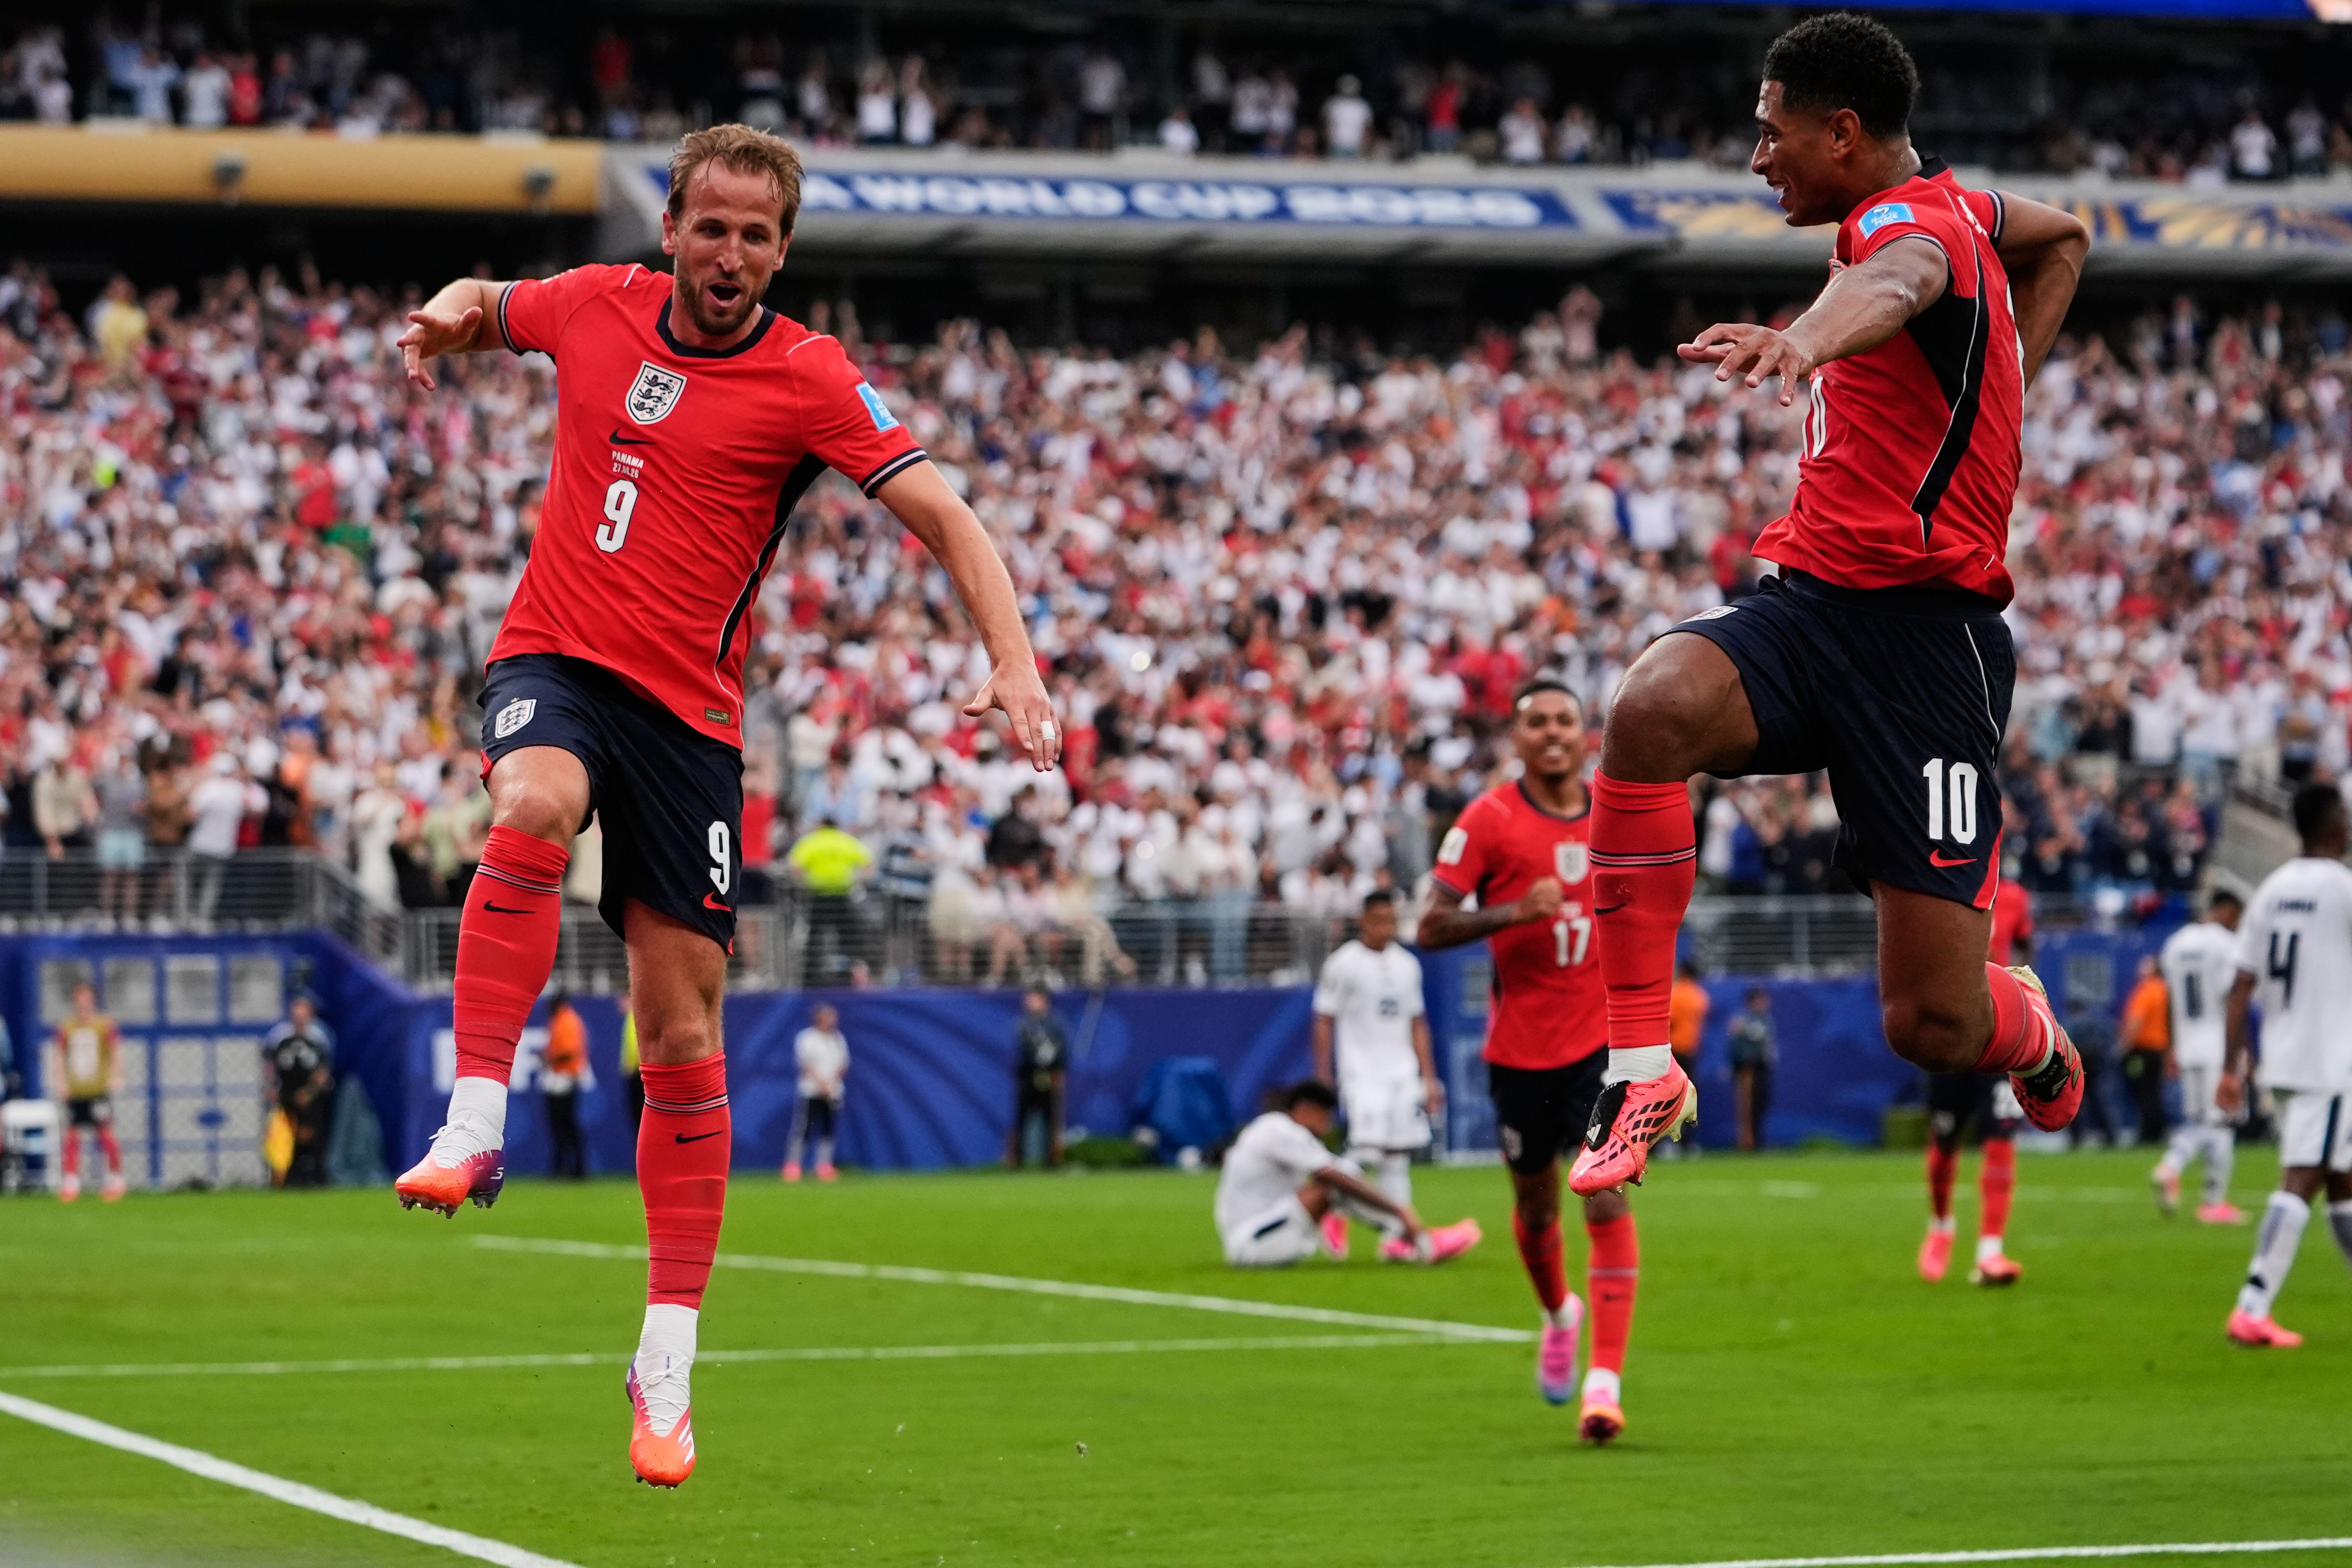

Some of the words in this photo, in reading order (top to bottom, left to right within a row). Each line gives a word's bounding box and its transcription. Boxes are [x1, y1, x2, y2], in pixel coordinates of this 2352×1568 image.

[852, 174, 1127, 218] WORLD
[1129, 181, 1276, 220] CUP
[612, 450, 644, 469] PANAMA
[595, 478, 639, 554] 9
[1922, 757, 1979, 846] 10
[708, 820, 730, 895] 9
[1552, 917, 1592, 967] 17
[2268, 931, 2300, 1008] 4
